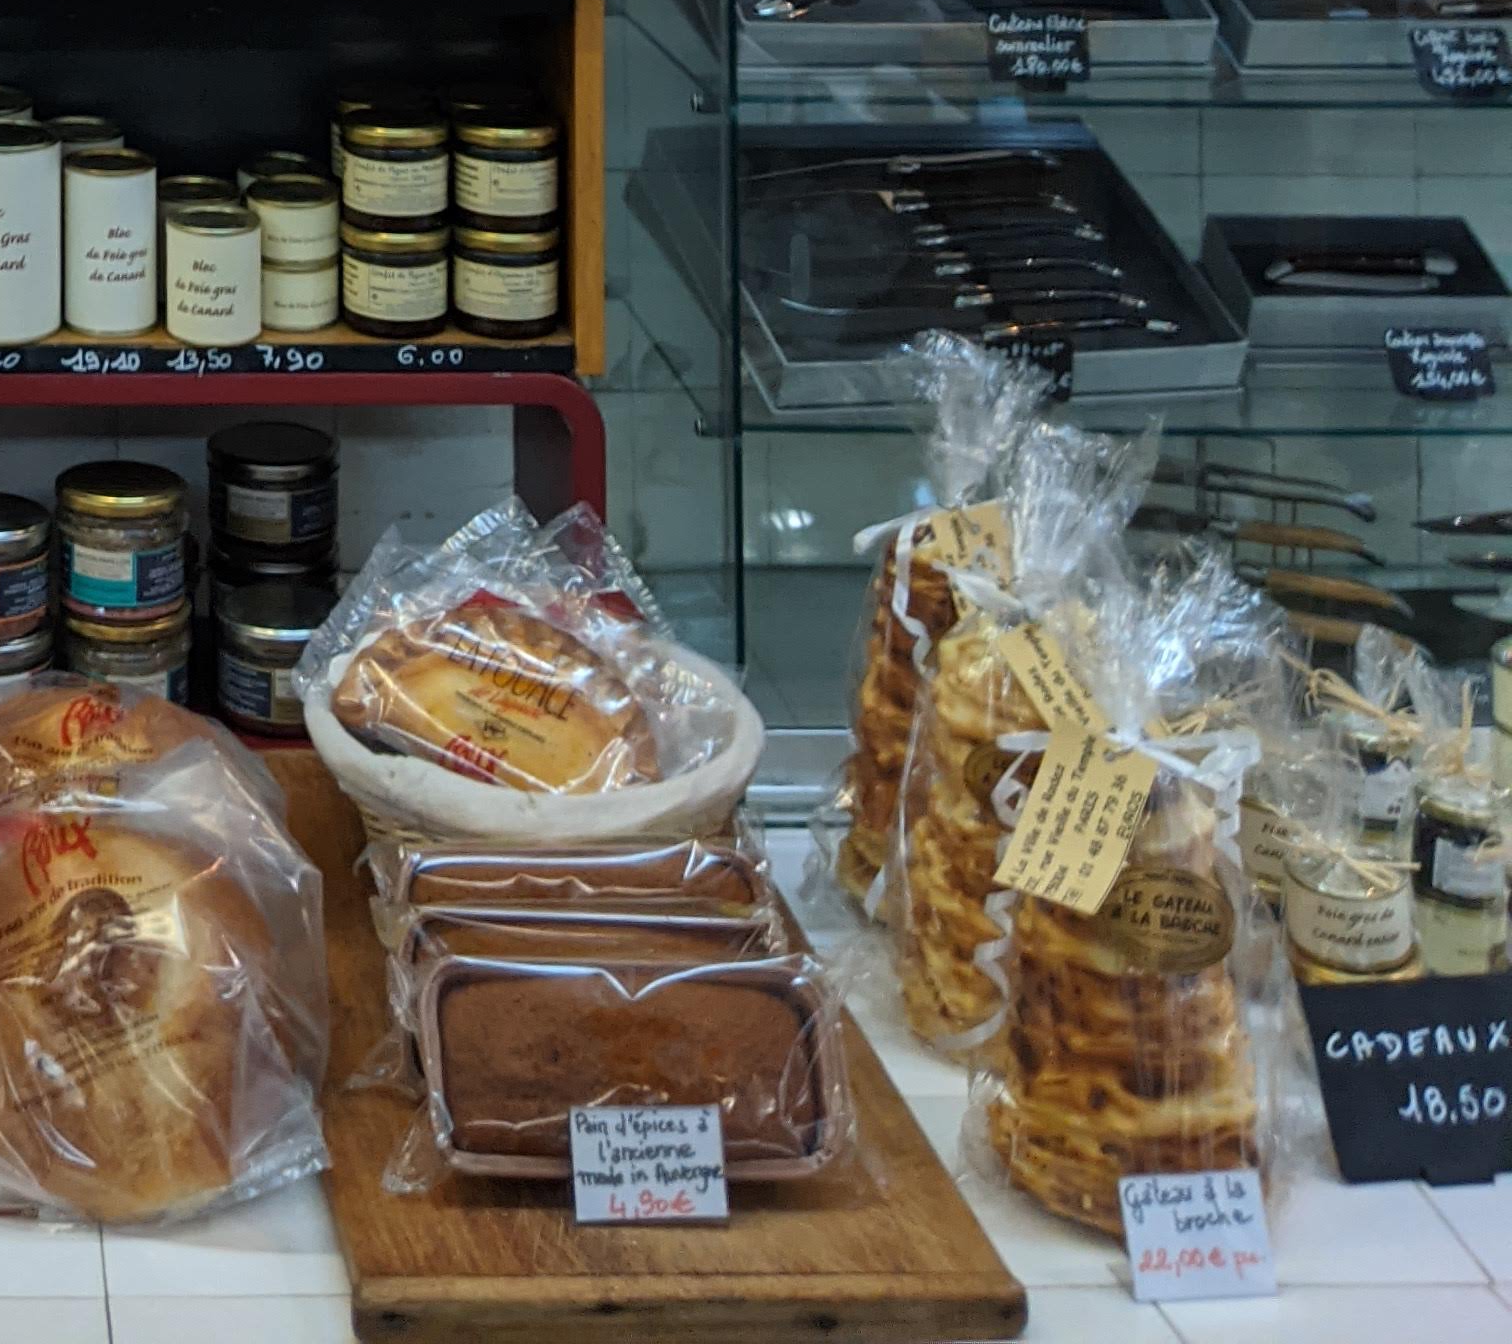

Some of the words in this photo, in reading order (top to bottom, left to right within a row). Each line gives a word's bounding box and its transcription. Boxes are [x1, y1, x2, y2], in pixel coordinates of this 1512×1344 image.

[0, 231, 32, 248] Gras
[167, 347, 233, 378] 13,50
[255, 344, 325, 372] 7,90
[397, 346, 465, 367] 6,00
[1326, 1018, 1512, 1062] CADEAUX
[575, 1112, 609, 1136] Pain
[615, 1111, 688, 1140] d'épices
[598, 1140, 696, 1163] l'ancienne
[577, 1166, 625, 1187] made
[631, 1164, 649, 1184] in
[654, 1162, 724, 1194] Auvergne
[1224, 1175, 1247, 1199] la
[1173, 1209, 1254, 1233] broche
